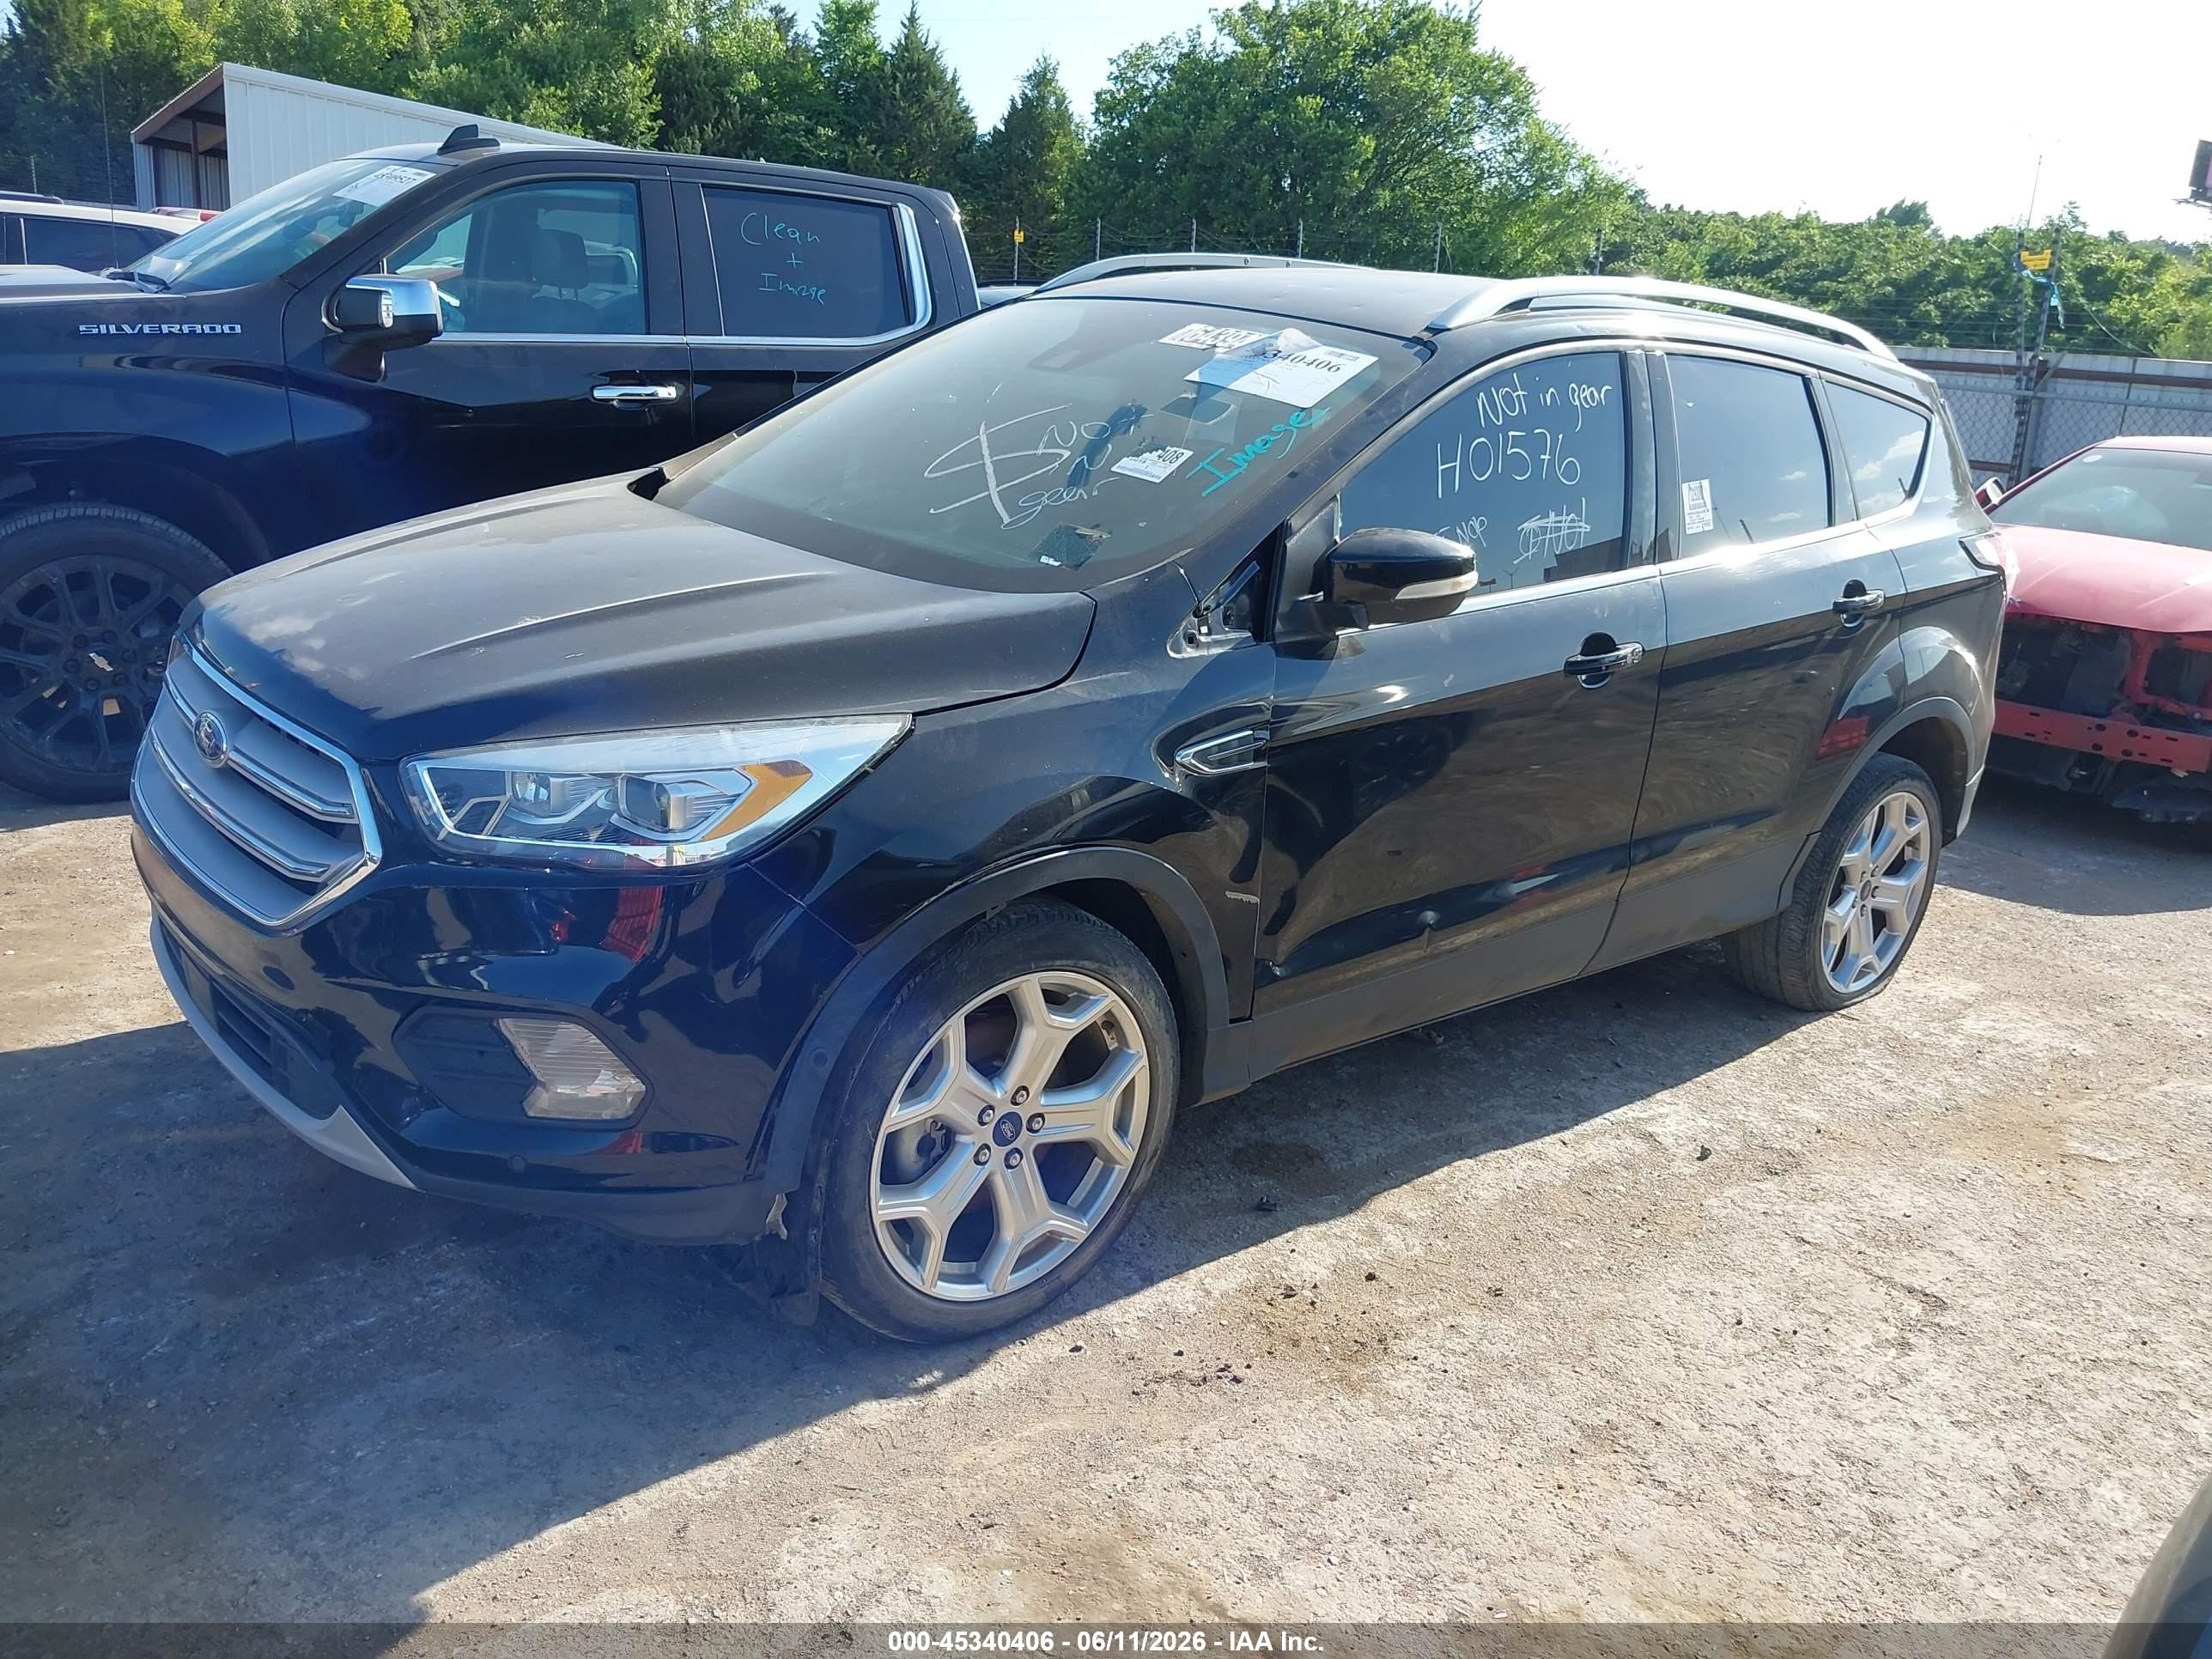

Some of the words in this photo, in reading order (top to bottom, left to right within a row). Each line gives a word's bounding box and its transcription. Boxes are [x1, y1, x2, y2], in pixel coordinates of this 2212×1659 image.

[740, 212, 821, 246] Clean
[78, 323, 242, 335] SILVERADO
[1535, 376, 1561, 407] in
[1568, 382, 1613, 432] gear
[1185, 406, 1331, 497] Image
